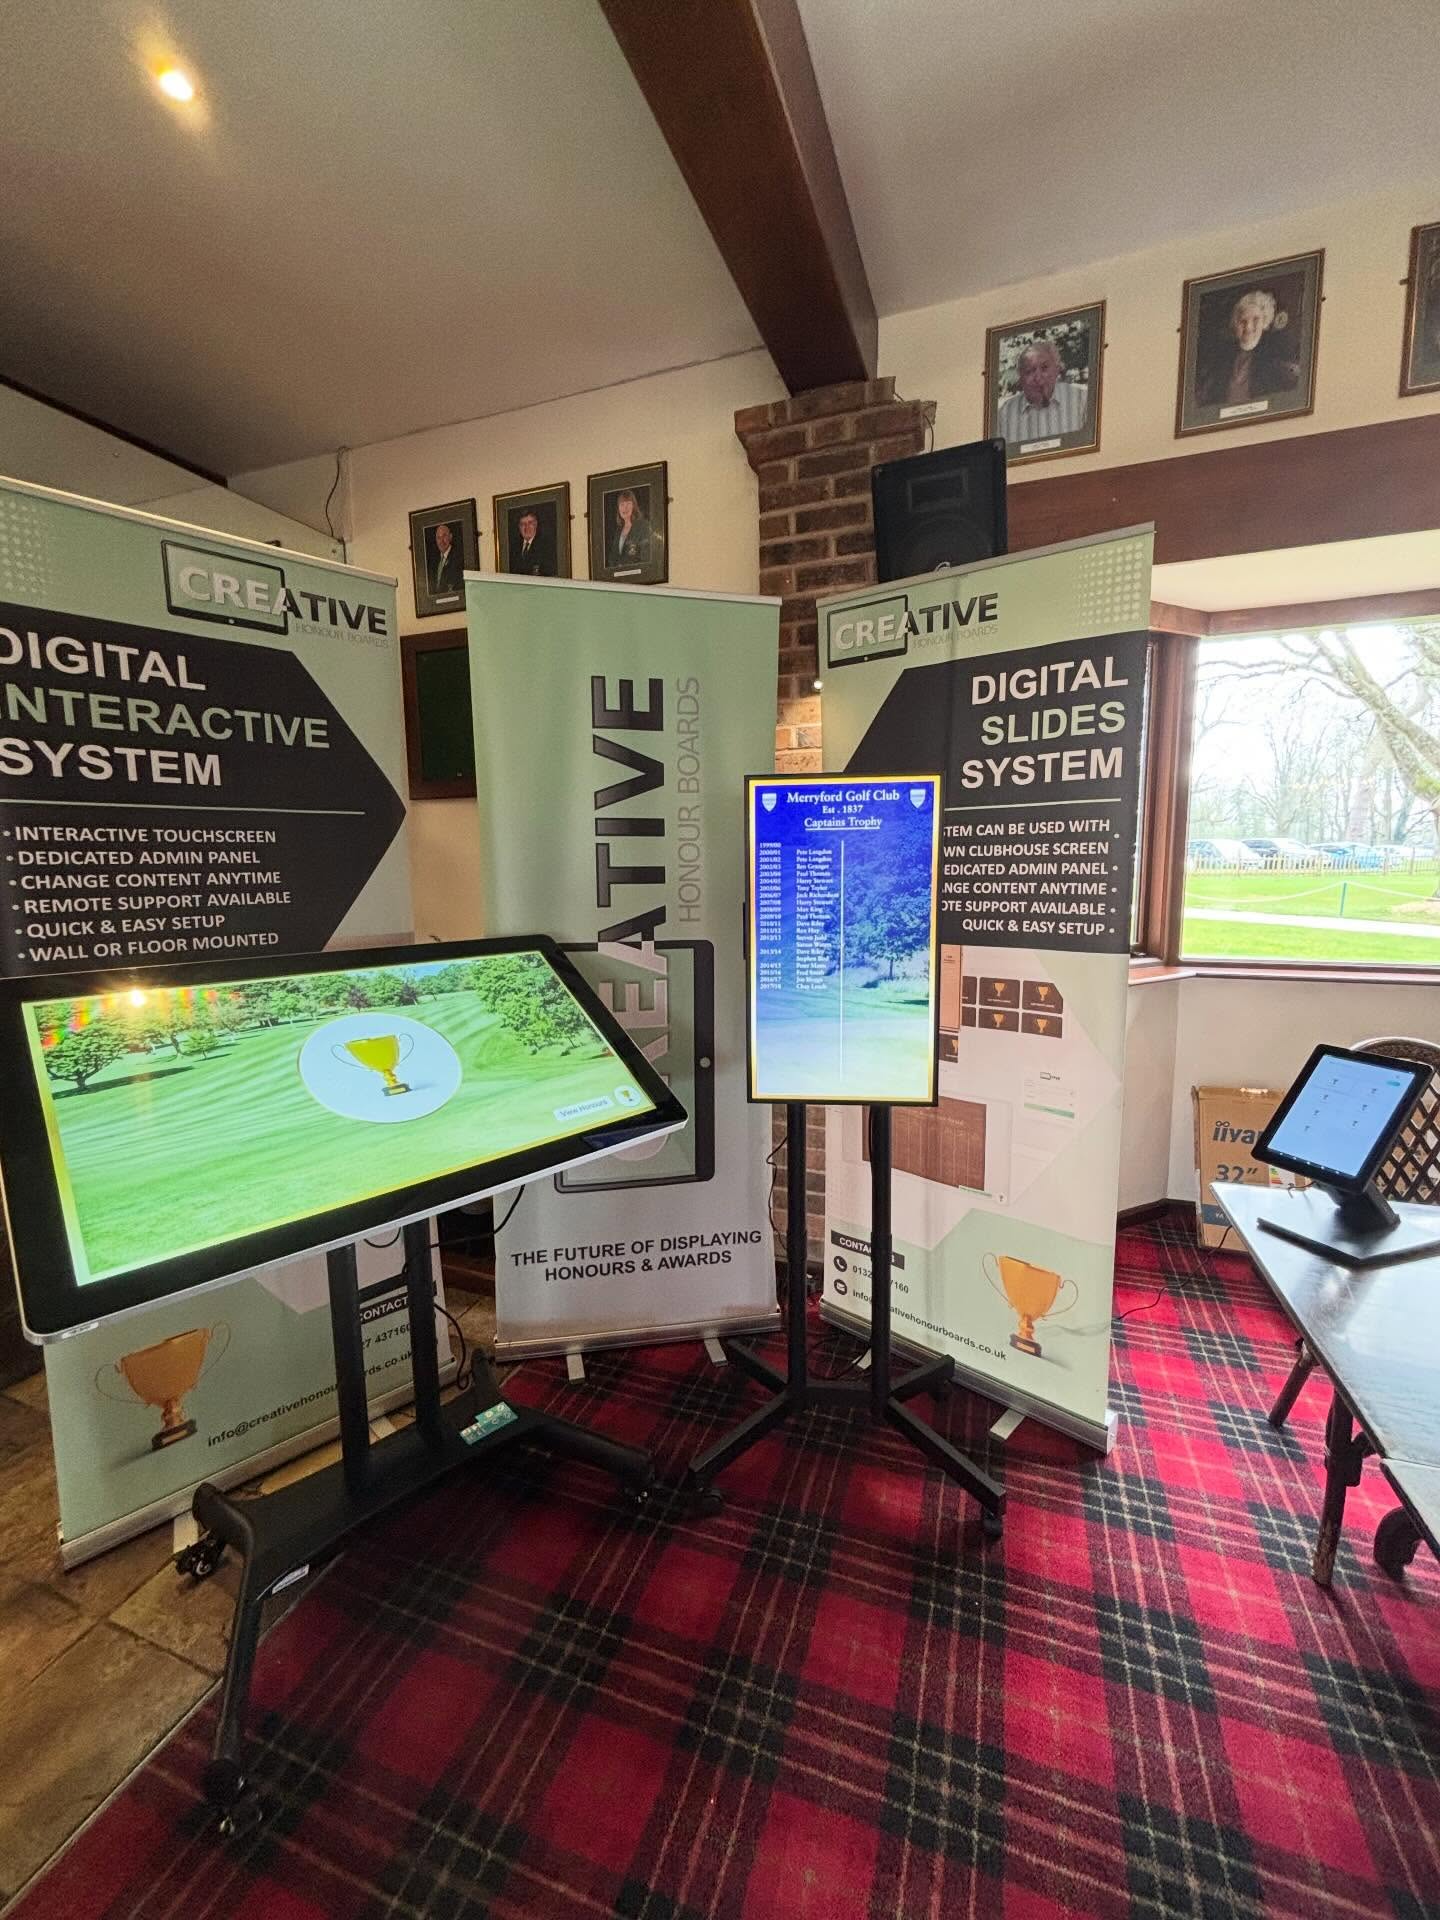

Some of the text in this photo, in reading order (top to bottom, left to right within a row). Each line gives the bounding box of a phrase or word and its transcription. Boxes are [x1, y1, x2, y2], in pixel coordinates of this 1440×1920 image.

[179, 566, 388, 636] CREATIVE
[835, 592, 998, 651] CREATIVE
[0, 628, 206, 691] DIGITAL
[971, 656, 1128, 705] DIGITAL
[0, 682, 329, 749] NTERACTIVE
[981, 701, 1126, 746] SLIDES
[0, 737, 222, 786] SYSTEM
[961, 747, 1122, 789] SYSTEM
[677, 677, 700, 922] HONOUR BOARDS
[787, 789, 900, 805] Merryford Golf Club
[822, 806, 835, 814] Est
[842, 805, 863, 813] 1837
[804, 816, 882, 829] Captains Trophy
[943, 819, 1110, 837] TEM CAN BE USED WITH
[15, 826, 276, 843] INTERACTIVE TOUCHSCREEN
[18, 851, 260, 865] DEDICATED ADMIN PANEL
[944, 842, 1109, 857] WN CLUBHOUSE SCREEN
[21, 871, 281, 890] CHANGE CONTENT ANYTIME
[944, 863, 1108, 875] EDICATED ADMIN PANEL
[942, 882, 1107, 895] NGE CONTENT ANYTIME
[24, 891, 291, 914] REMOTE SUPPORT AVAILABLE
[942, 900, 1106, 915] OTE SUPPORT AVAILABLE
[27, 914, 225, 939] QUICK & EASY SETUP
[591, 676, 668, 1160] EATIVE
[962, 919, 1105, 936] QUICK & EASY SETUP
[29, 932, 279, 962] WALL OR FLOOR MOUNTED
[1213, 1120, 1263, 1145] iiya
[1215, 1164, 1258, 1184] 32"
[512, 1230, 762, 1266] THE FUTURE OF DISPLAYING
[840, 1237, 872, 1254] CONTA
[545, 1250, 732, 1281] HONOURS & AWARDS
[853, 1265, 872, 1278] 0132
